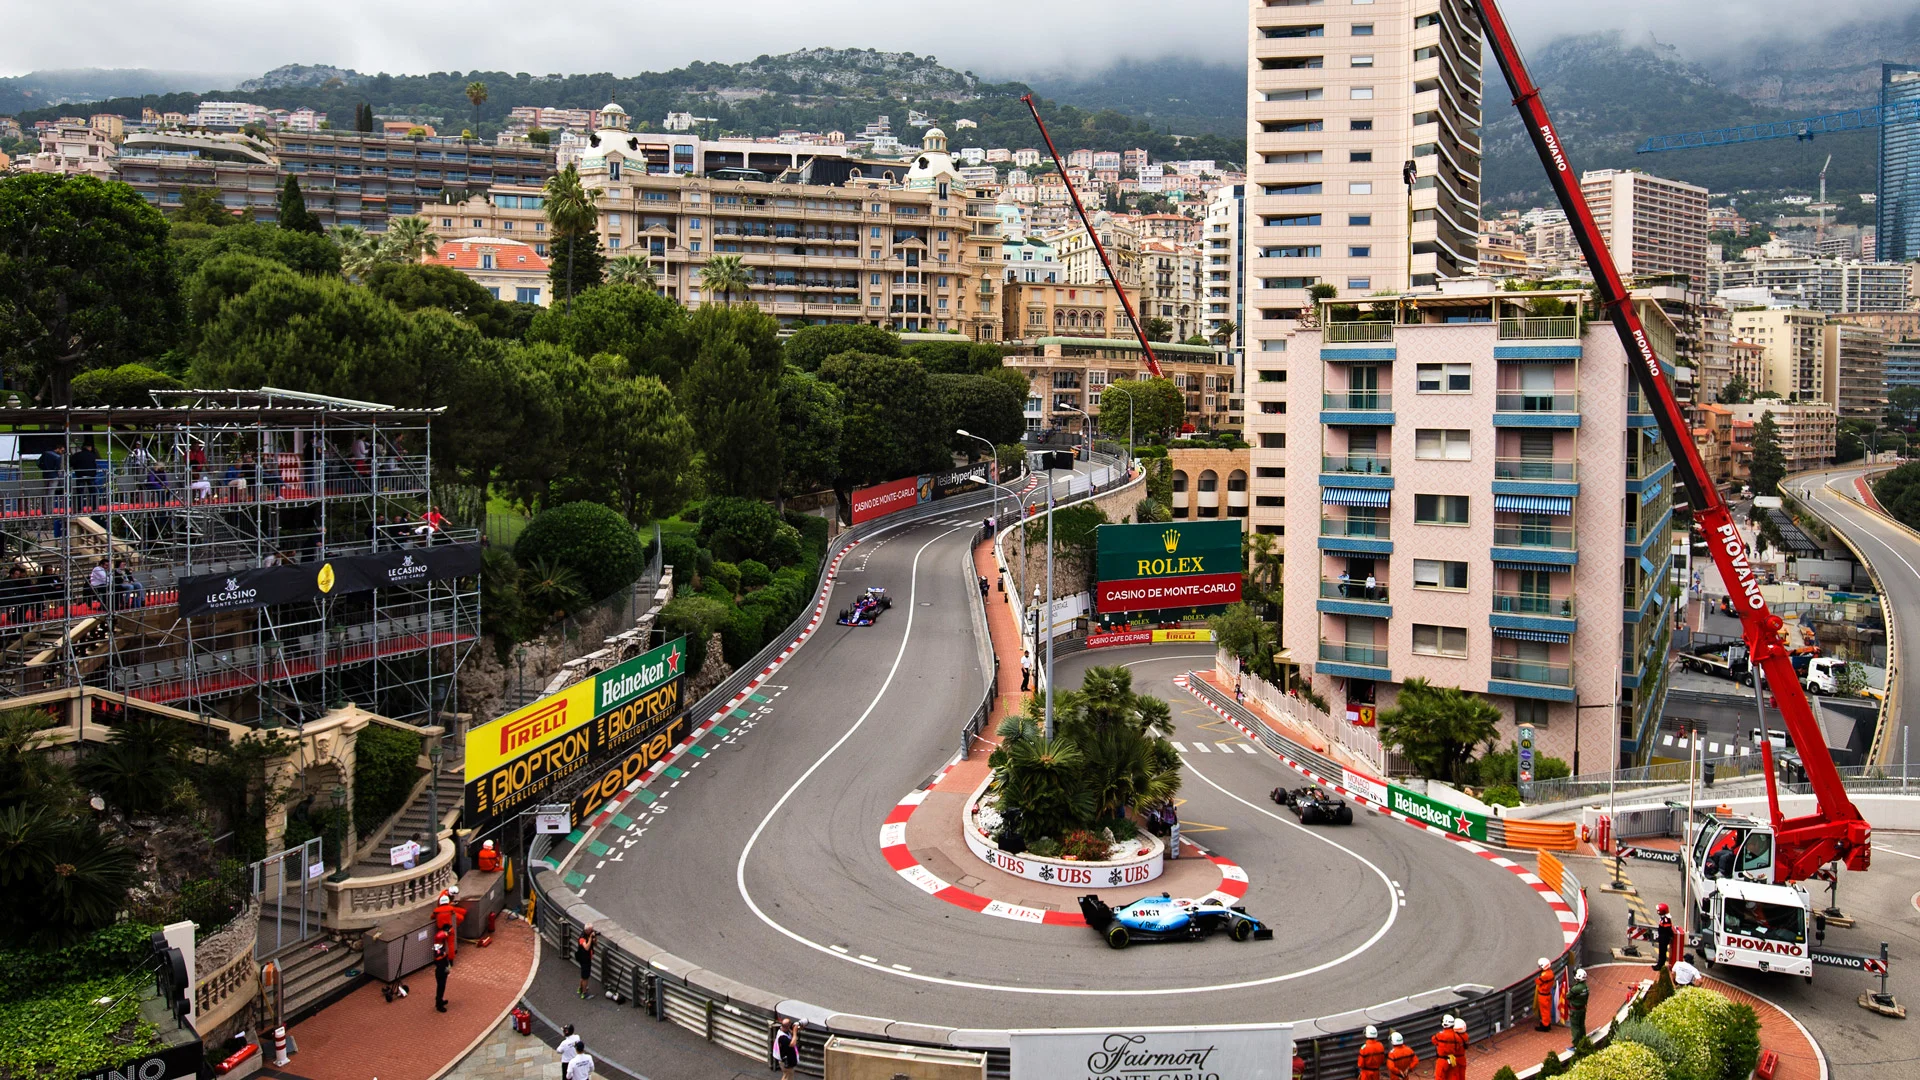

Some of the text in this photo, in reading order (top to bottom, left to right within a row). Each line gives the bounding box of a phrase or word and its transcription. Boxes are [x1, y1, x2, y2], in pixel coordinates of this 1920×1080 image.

[1540, 124, 1567, 172] PIOVANO
[1632, 329, 1660, 377] PIOVANO
[936, 473, 951, 487] Tesla
[854, 487, 915, 513] CASINO DE MONTE-CARLO
[388, 564, 428, 577] LE CASINO
[1137, 556, 1204, 576] ROLEX
[1716, 523, 1765, 610] PIOVANO
[206, 588, 257, 604] LE CASINO
[1106, 582, 1236, 601] CASINO DE MONTE-CARLO
[1183, 613, 1205, 621] ROLEX
[1089, 636, 1109, 645] CASINO
[1109, 635, 1124, 643] CAFE
[1132, 633, 1150, 641] PARIS
[1166, 631, 1196, 640] PIRELLI
[602, 660, 665, 708] Heineken
[608, 681, 678, 740] BIOPTRON
[500, 698, 568, 756] PIRELLI
[608, 705, 676, 750] HYPERLIGHT THERAPY
[725, 705, 774, 745] TAXIS
[492, 727, 590, 804] BIOPTRON
[582, 717, 683, 817] zepter
[492, 755, 589, 817] HYPERLIGHT THERAPY
[1347, 773, 1370, 791] MONACO
[1394, 791, 1452, 829] Heineken
[609, 805, 669, 862] TAXIS
[997, 854, 1025, 875] UBS
[1637, 848, 1678, 862] PIOVANO
[916, 874, 943, 892] UBS
[1057, 867, 1092, 884] UBS
[1124, 864, 1150, 883] UBS
[1006, 907, 1041, 921] UBS
[1145, 921, 1171, 931] Rexona
[1726, 936, 1803, 956] PIOVANO
[1811, 953, 1861, 968] PIOVANO
[1087, 1033, 1219, 1075] Fairmont
